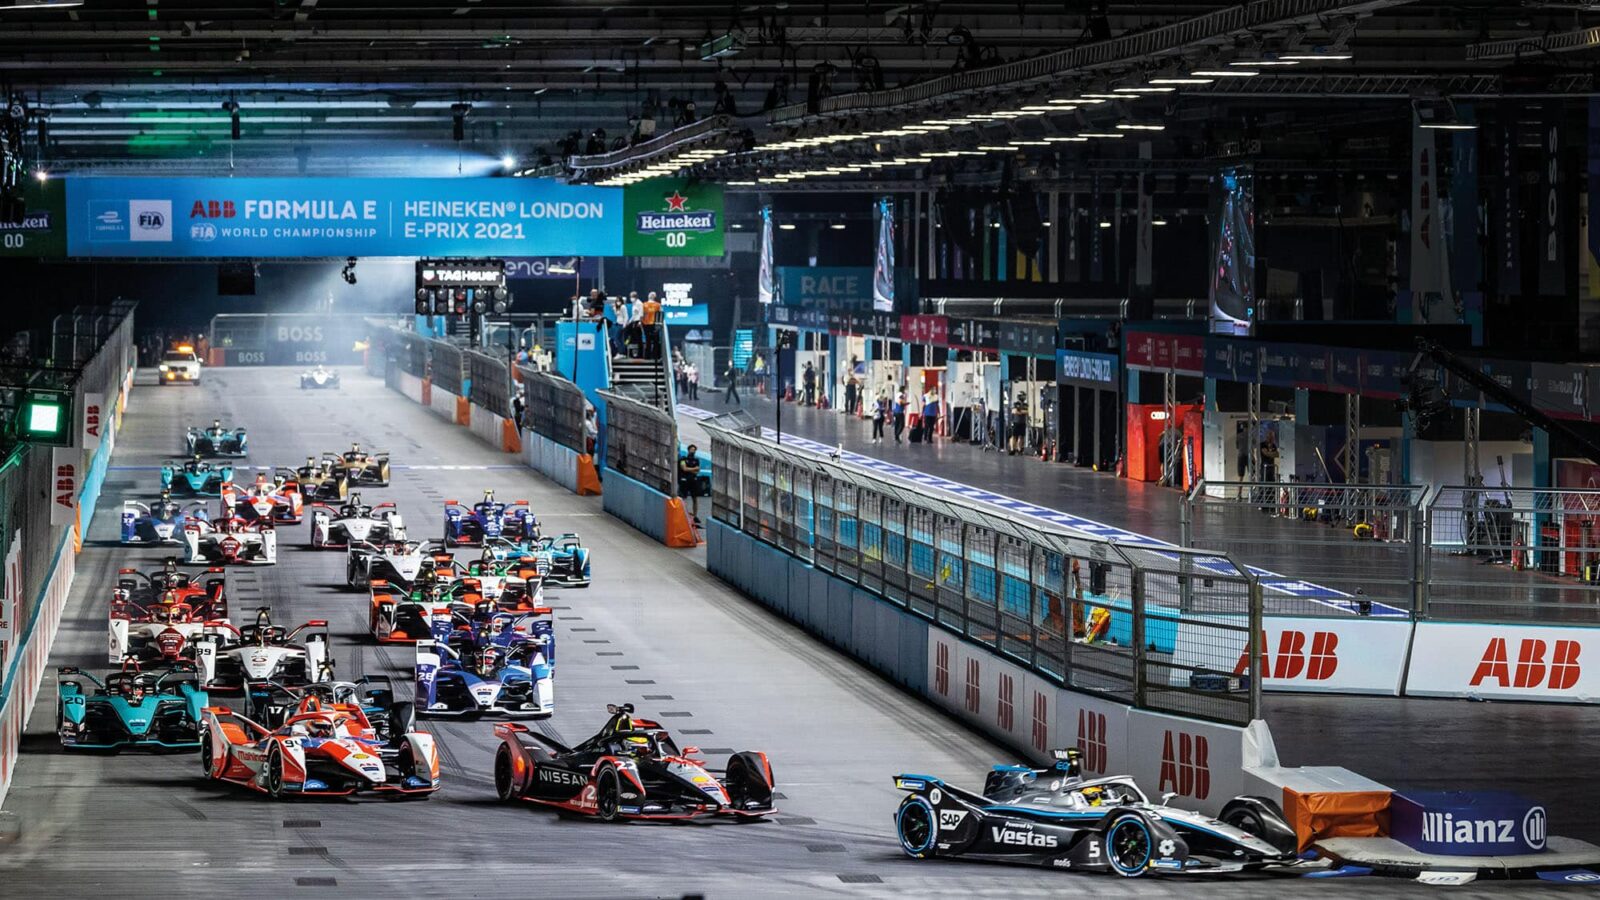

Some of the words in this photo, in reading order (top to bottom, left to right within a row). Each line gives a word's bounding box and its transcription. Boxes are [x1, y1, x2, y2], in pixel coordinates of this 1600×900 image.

[1420, 148, 1430, 249] ABB
[190, 201, 237, 218] ABB
[244, 200, 358, 219] FORMULA
[363, 200, 377, 219] E
[520, 202, 603, 219] LONDON
[139, 214, 162, 226] FIA
[642, 213, 711, 230] Heineken
[191, 225, 216, 239] FIA
[221, 228, 269, 238] WORLD
[273, 227, 377, 238] CHAMPIONSHIP
[404, 223, 469, 239] E-PRIX
[474, 223, 525, 239] 2021
[4, 233, 24, 248] 0.0
[666, 232, 686, 248] 0.0
[437, 270, 461, 281] TAG
[800, 275, 859, 294] RACE
[278, 326, 323, 342] BOSS
[238, 352, 265, 363] BOSS
[296, 351, 327, 362] BOSS
[1573, 372, 1583, 405] 22
[87, 404, 100, 437] ABB
[56, 464, 75, 509] ABB
[1232, 630, 1339, 680] ABB
[1469, 637, 1581, 690] ABB
[418, 672, 434, 681] 28
[935, 641, 949, 696] ABB
[965, 657, 980, 714] ABB
[65, 696, 84, 706] 20
[997, 672, 1013, 732] ABB
[268, 706, 284, 714] 17
[1032, 690, 1047, 753] ABB
[1077, 708, 1107, 775] ABB
[1159, 730, 1210, 800] ABB
[539, 769, 589, 786] NISSAN
[941, 813, 960, 826] SAP
[1421, 811, 1516, 844] Allianz
[991, 826, 1058, 848] Vestas
[1088, 841, 1101, 858] 5
